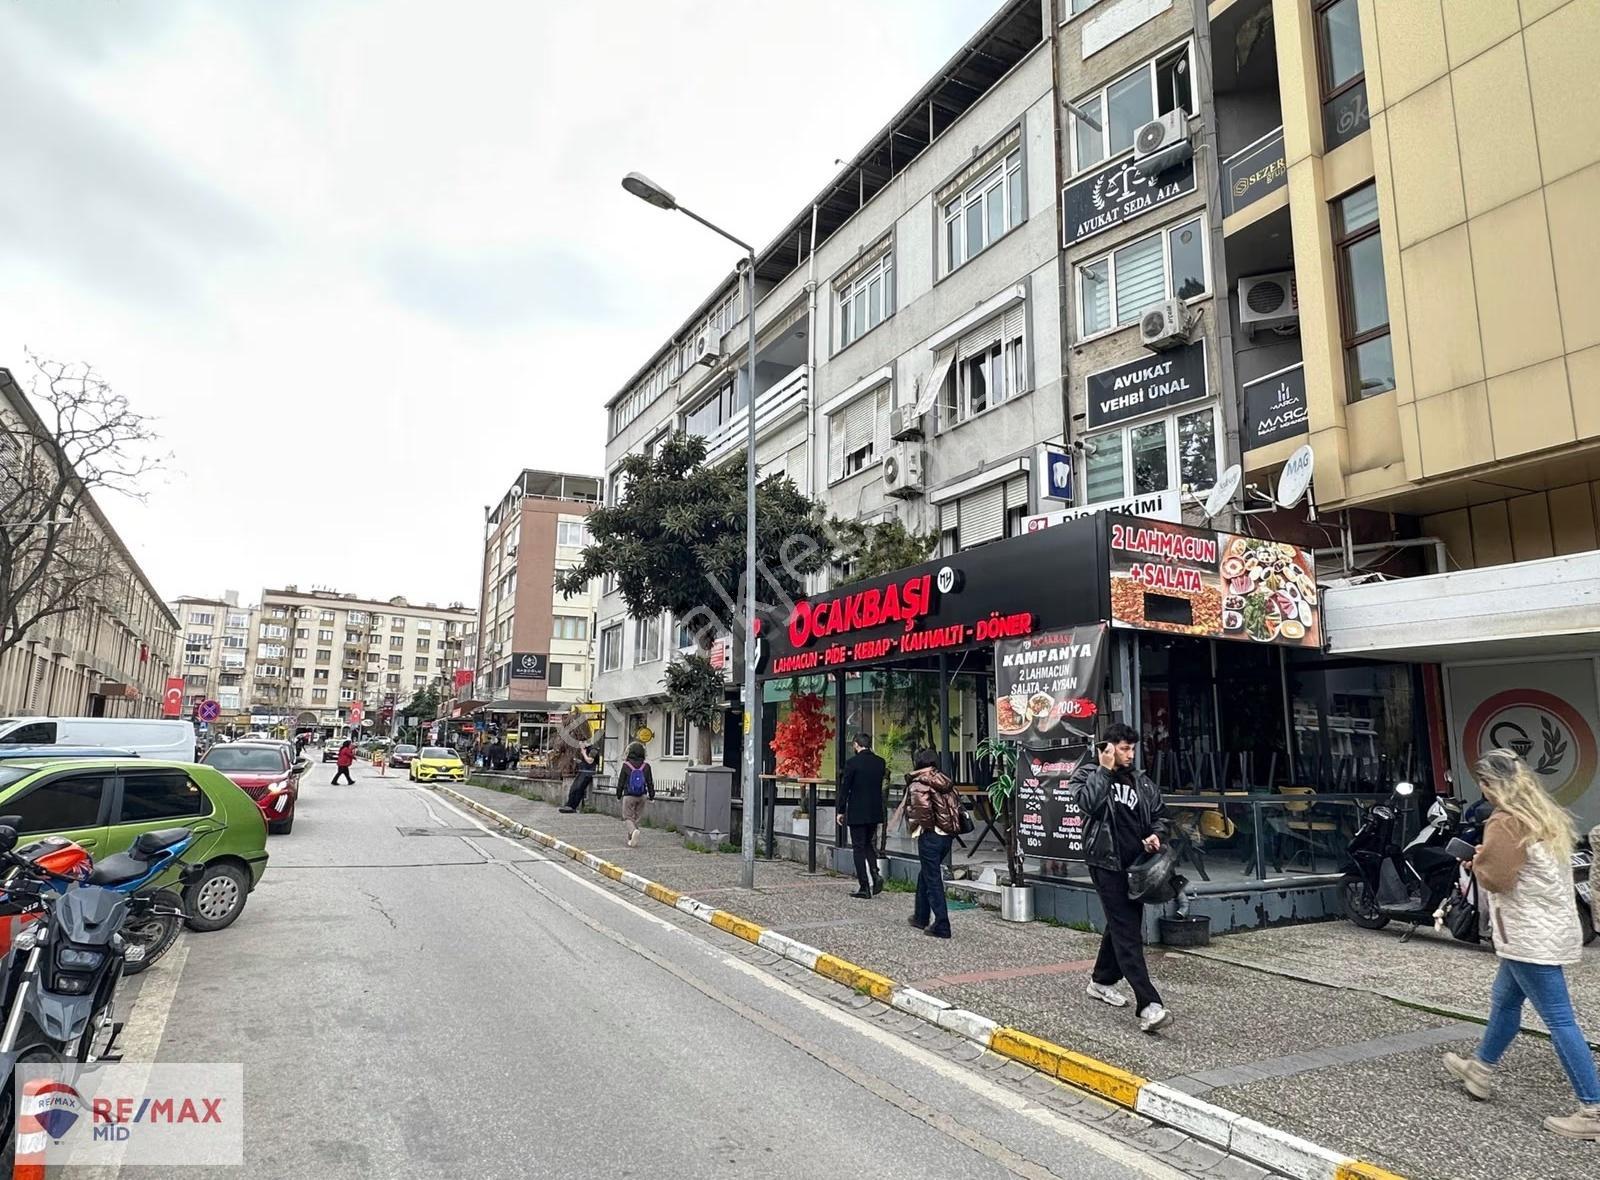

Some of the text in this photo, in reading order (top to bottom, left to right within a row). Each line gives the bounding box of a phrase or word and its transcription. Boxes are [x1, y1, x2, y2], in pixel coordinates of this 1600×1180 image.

[1249, 158, 1285, 185] SEZER
[1077, 182, 1180, 236] AVUKAT SEDA ATA
[1113, 361, 1172, 390] AVUKAT
[1100, 378, 1190, 413] VEHBİ ÜNAL
[1286, 452, 1309, 476] MAG
[1100, 495, 1162, 515] EKİMİ
[1112, 525, 1216, 563] 2 LAHMACUN
[1144, 563, 1202, 592] SALATA
[789, 574, 931, 648] OCAKBAŞI
[773, 651, 817, 673] LAHMACUN
[825, 642, 846, 665] PİDE
[854, 638, 890, 660] KEBAP
[901, 624, 964, 653] KAHVALTI
[976, 612, 1032, 641] DÖNER
[1002, 644, 1091, 667] KAMPANYA
[1011, 682, 1040, 695] SALATA
[1052, 677, 1077, 692] AYRAN
[1019, 664, 1070, 681] 2 LAHMACUN
